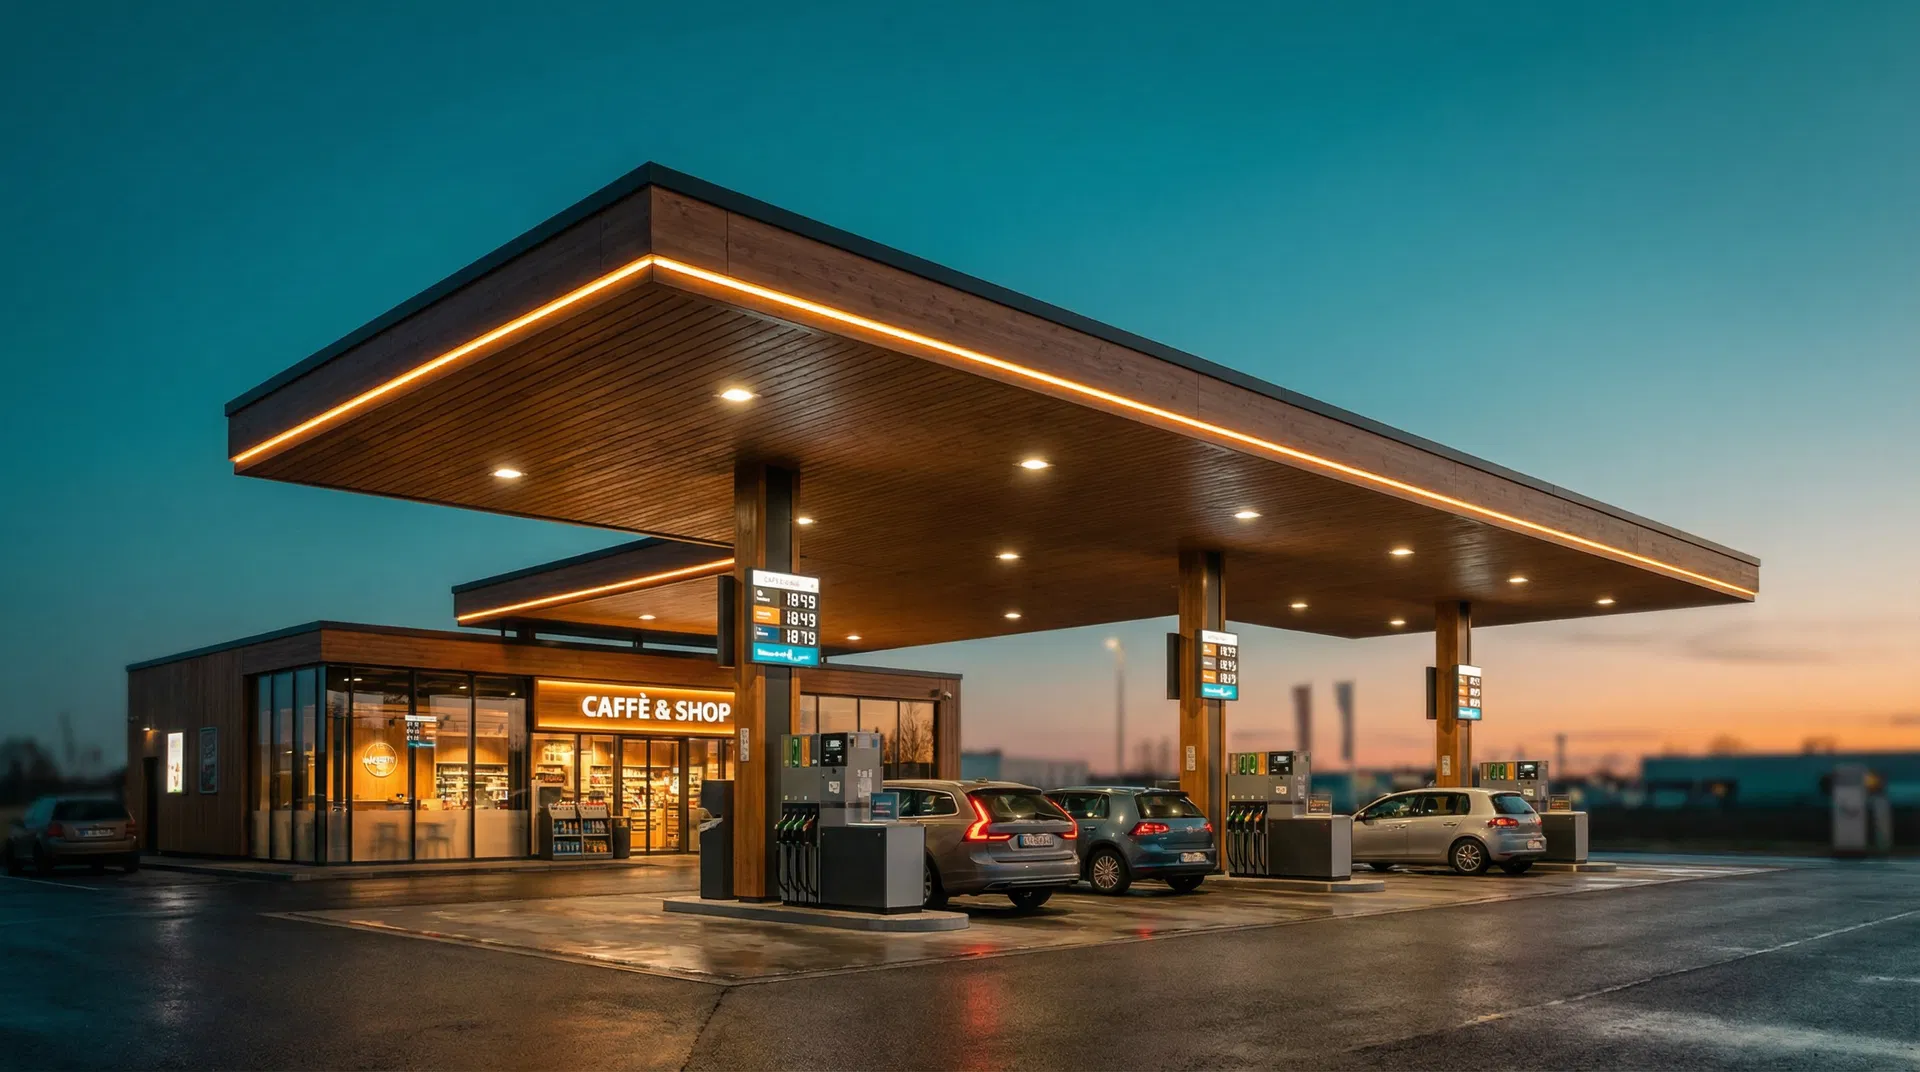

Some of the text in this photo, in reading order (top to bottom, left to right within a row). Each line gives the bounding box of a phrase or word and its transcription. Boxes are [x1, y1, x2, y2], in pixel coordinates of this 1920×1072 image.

[581, 692, 731, 723] CAFFÈ & SHOP
